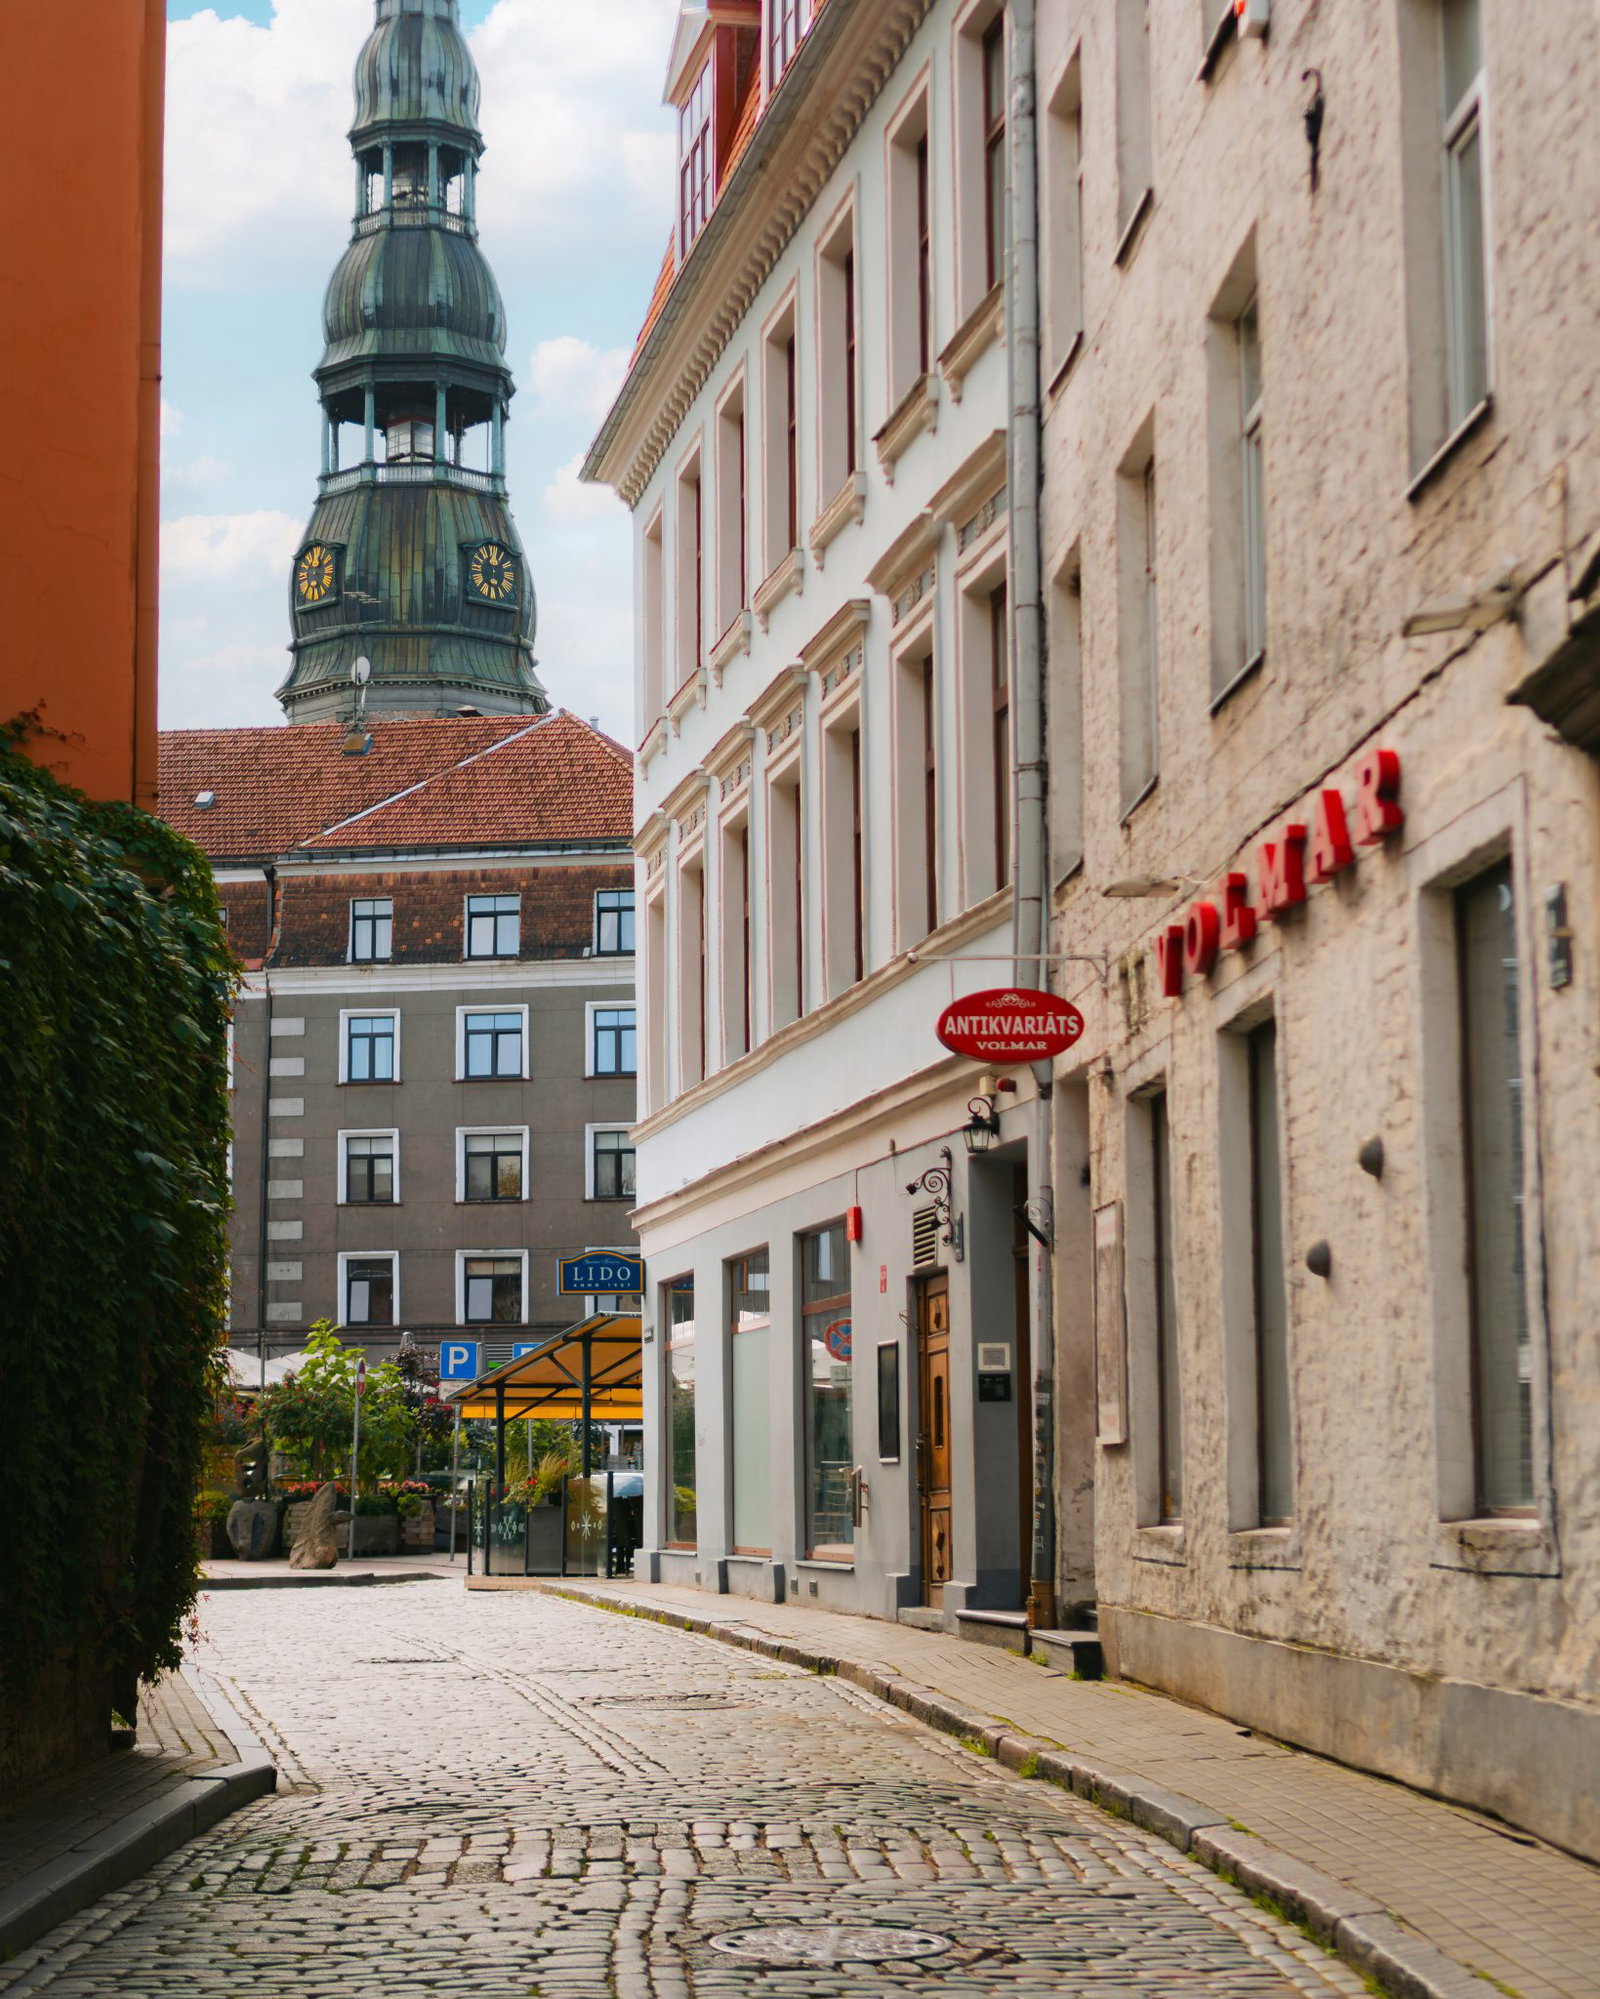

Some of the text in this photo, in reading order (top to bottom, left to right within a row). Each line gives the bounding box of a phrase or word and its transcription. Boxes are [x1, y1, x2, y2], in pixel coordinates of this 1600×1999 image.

[1154, 749, 1404, 997] VOLMAR
[944, 1012, 1079, 1036] ANTIKVARIĀTS
[976, 1041, 1048, 1050] VOLMAR
[573, 1266, 631, 1281] LIDO
[448, 1346, 469, 1375] P
